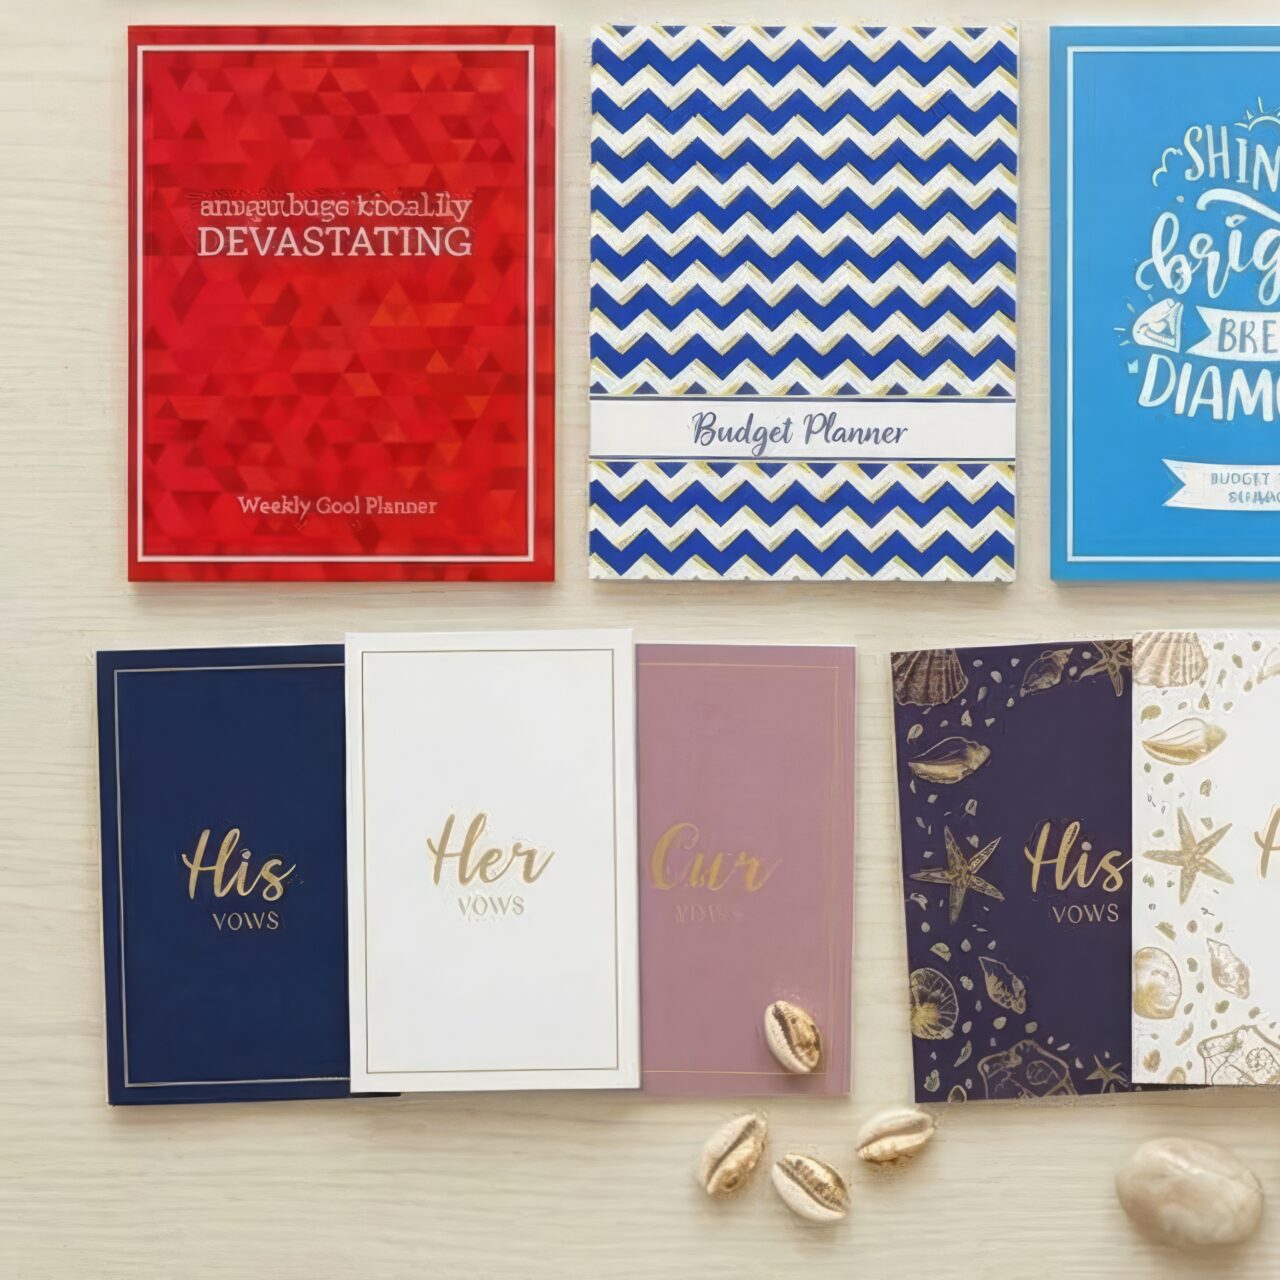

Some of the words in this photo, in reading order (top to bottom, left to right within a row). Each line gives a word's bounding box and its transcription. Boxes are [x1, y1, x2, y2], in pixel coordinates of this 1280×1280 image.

[198, 226, 473, 257] DEVASTATING
[691, 411, 794, 456] Budget
[803, 411, 908, 445] Planner
[237, 495, 311, 521] Weekly
[181, 827, 297, 902] His
[426, 811, 556, 887] Her
[1024, 820, 1132, 893] His
[212, 910, 280, 931] VOWS
[457, 893, 526, 917] VOWS
[1052, 903, 1120, 924] VOWS
